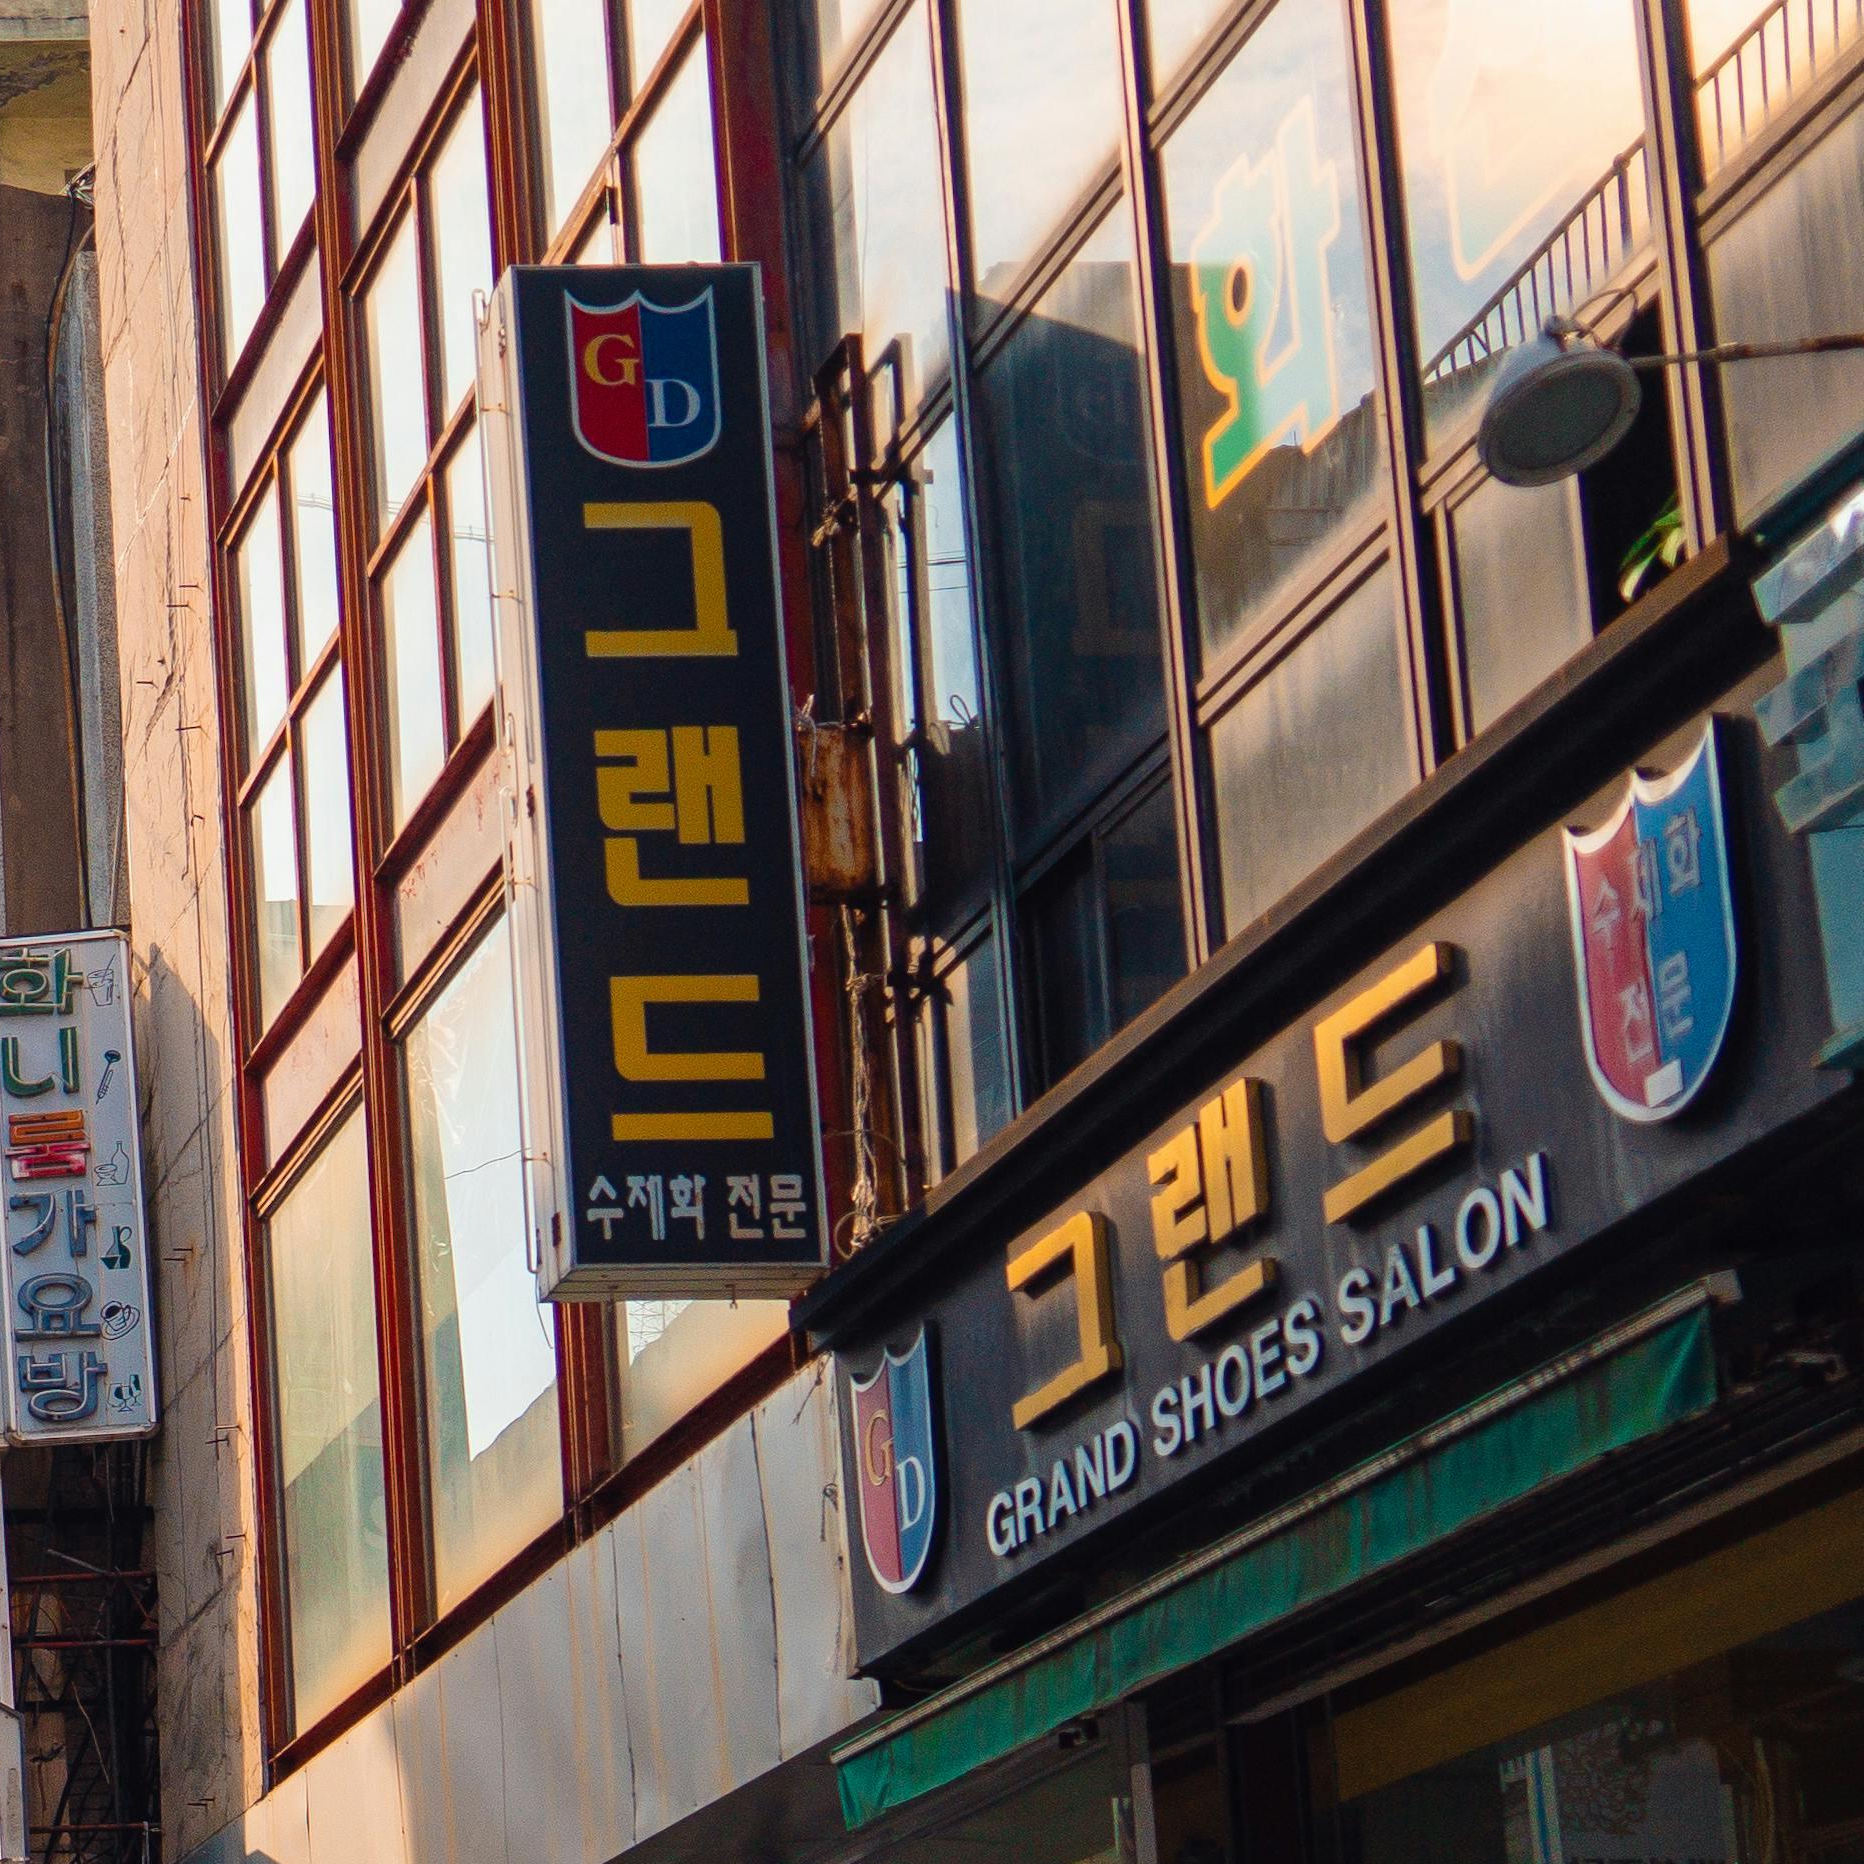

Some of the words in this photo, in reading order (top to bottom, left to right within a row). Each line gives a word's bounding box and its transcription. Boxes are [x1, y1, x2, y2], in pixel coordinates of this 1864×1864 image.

[584, 332, 639, 387] G
[648, 378, 702, 429] D
[583, 499, 775, 1141] 그랜드
[586, 1171, 707, 1243] 수제화
[726, 1171, 808, 1241] 전문
[1006, 939, 1472, 1432] 그랜드
[9, 1190, 108, 1423] 가요방
[985, 1419, 1135, 1556] GRAND
[1151, 1297, 1324, 1458] SHOES
[1336, 1151, 1549, 1347] SALON
[862, 1411, 894, 1488] G
[897, 1454, 926, 1529] D
